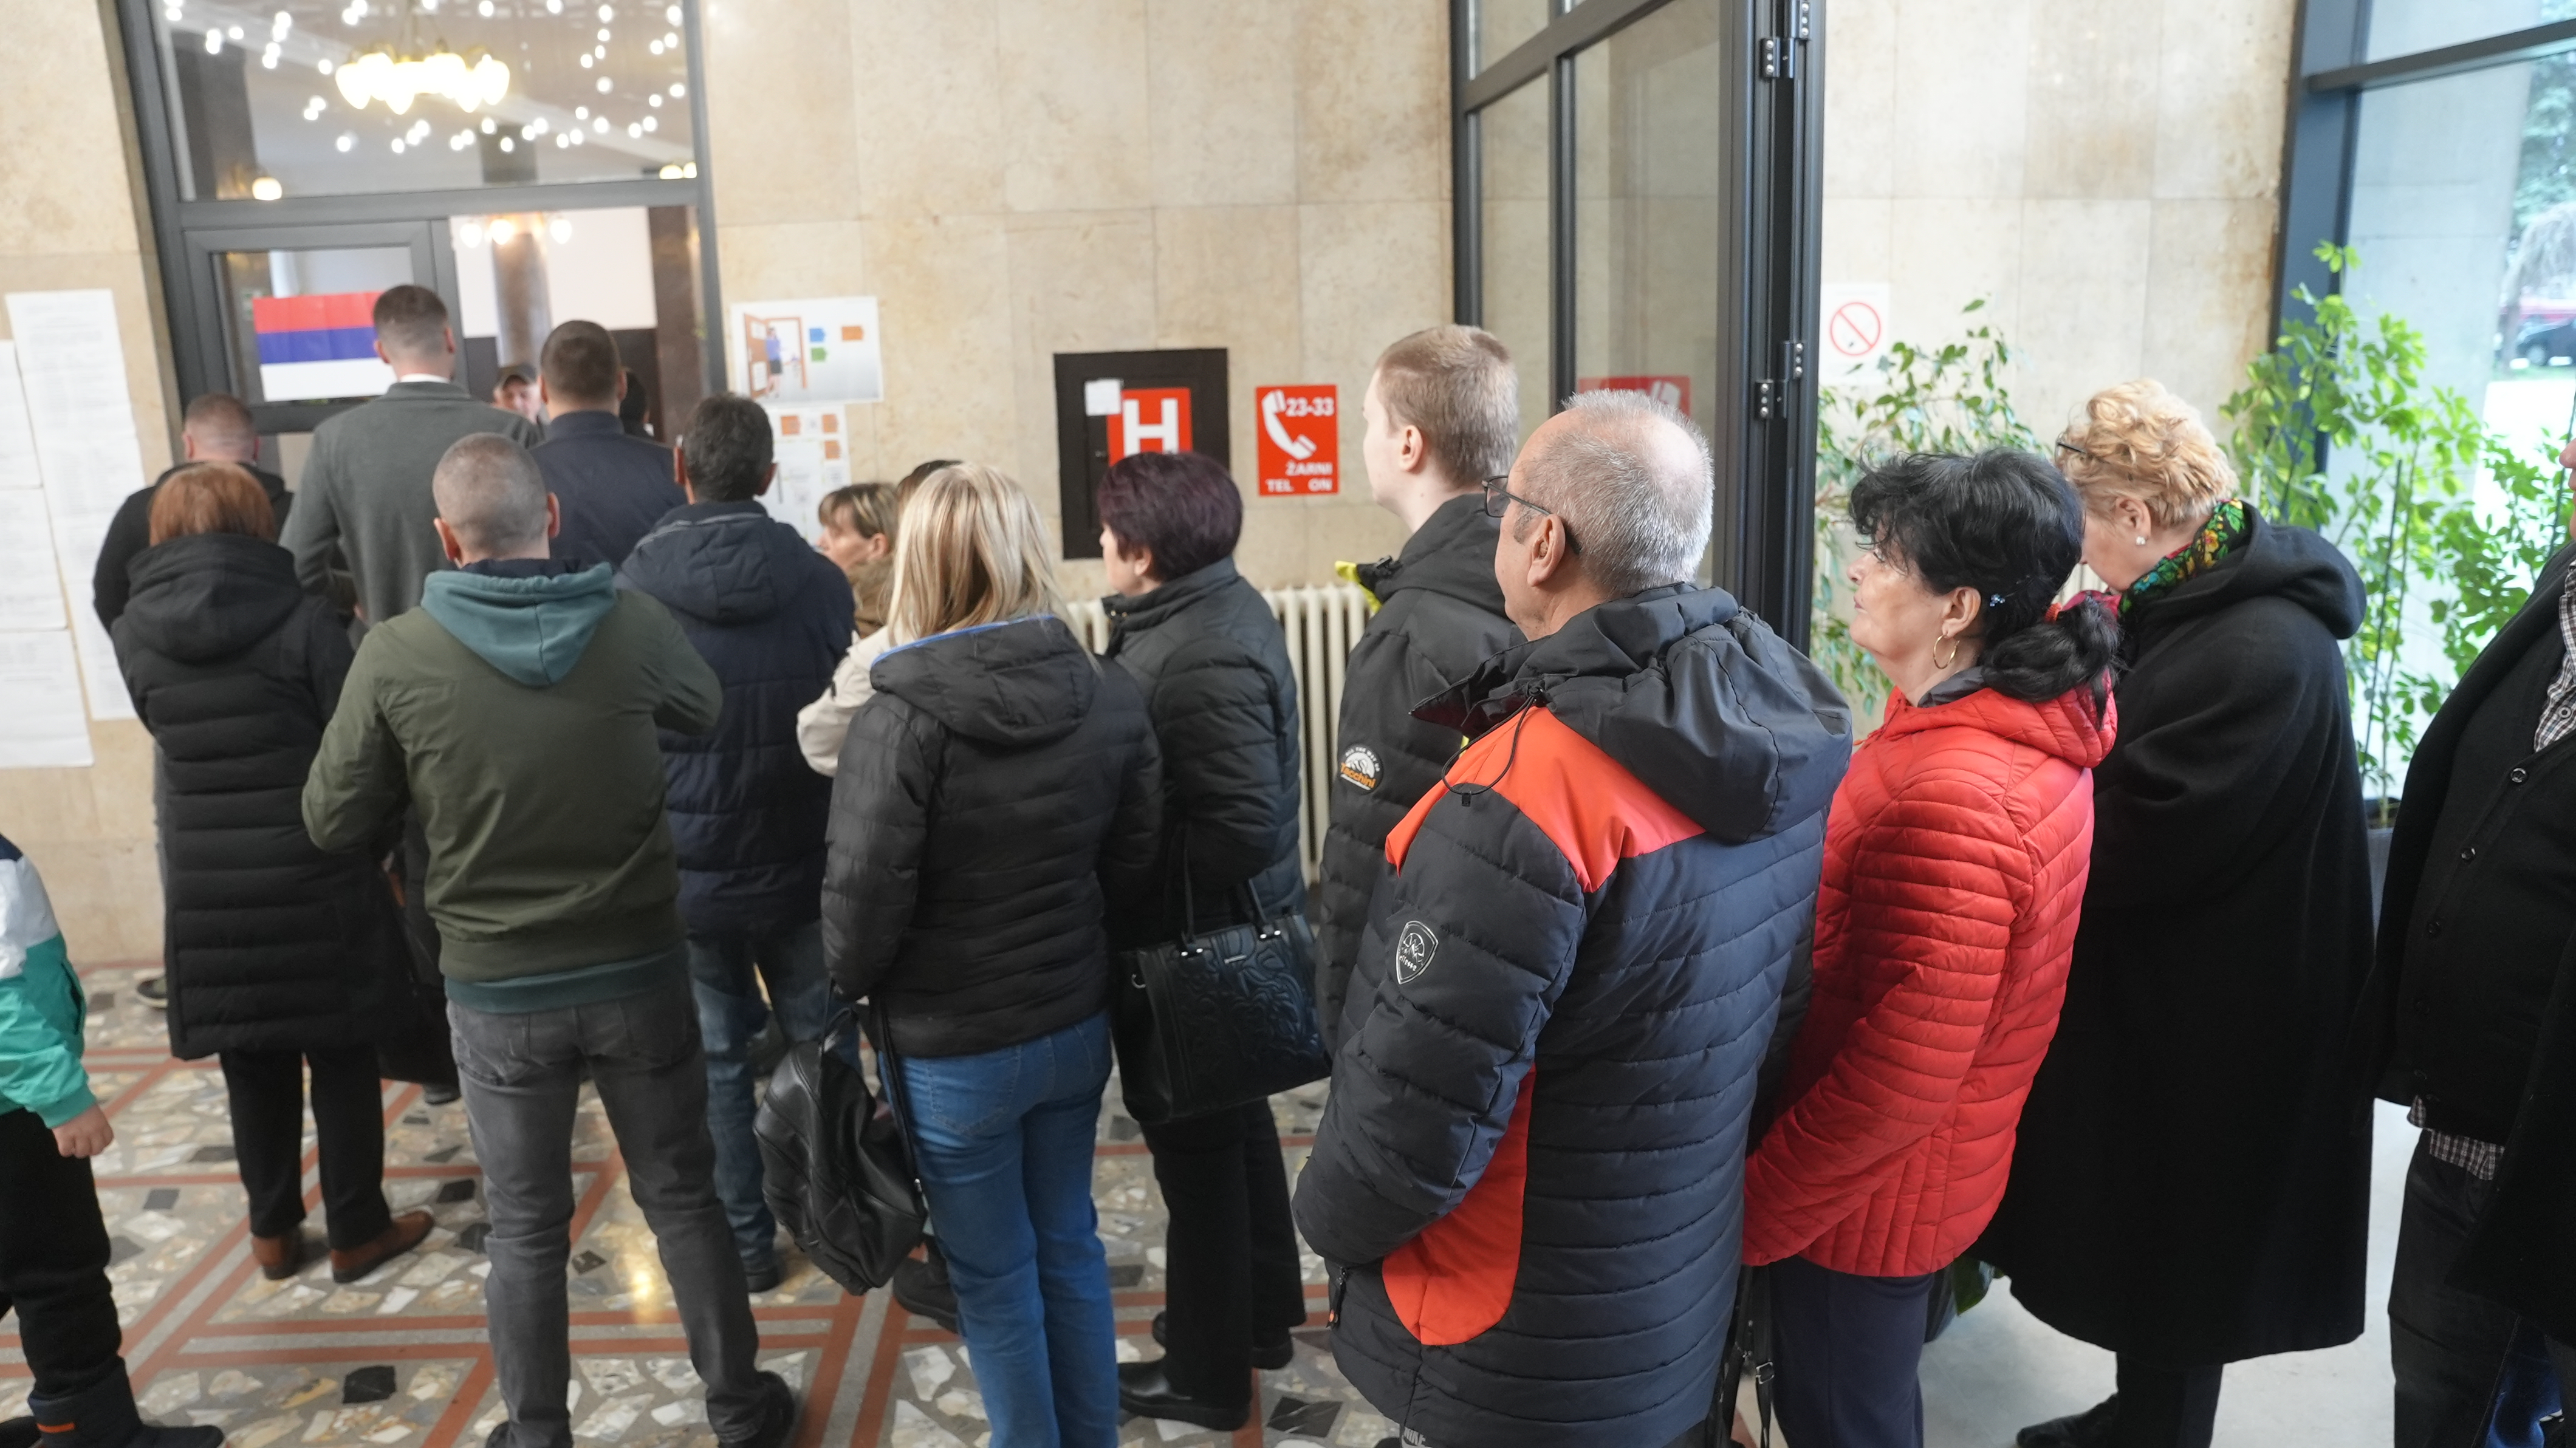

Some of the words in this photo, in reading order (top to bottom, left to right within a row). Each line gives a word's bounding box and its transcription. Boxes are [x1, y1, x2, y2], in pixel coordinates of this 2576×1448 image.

[1285, 397, 1335, 417] 23-33
[1123, 398, 1179, 457] H
[1340, 762, 1377, 788] Tacchini
[1399, 955, 1417, 971] ellesse
